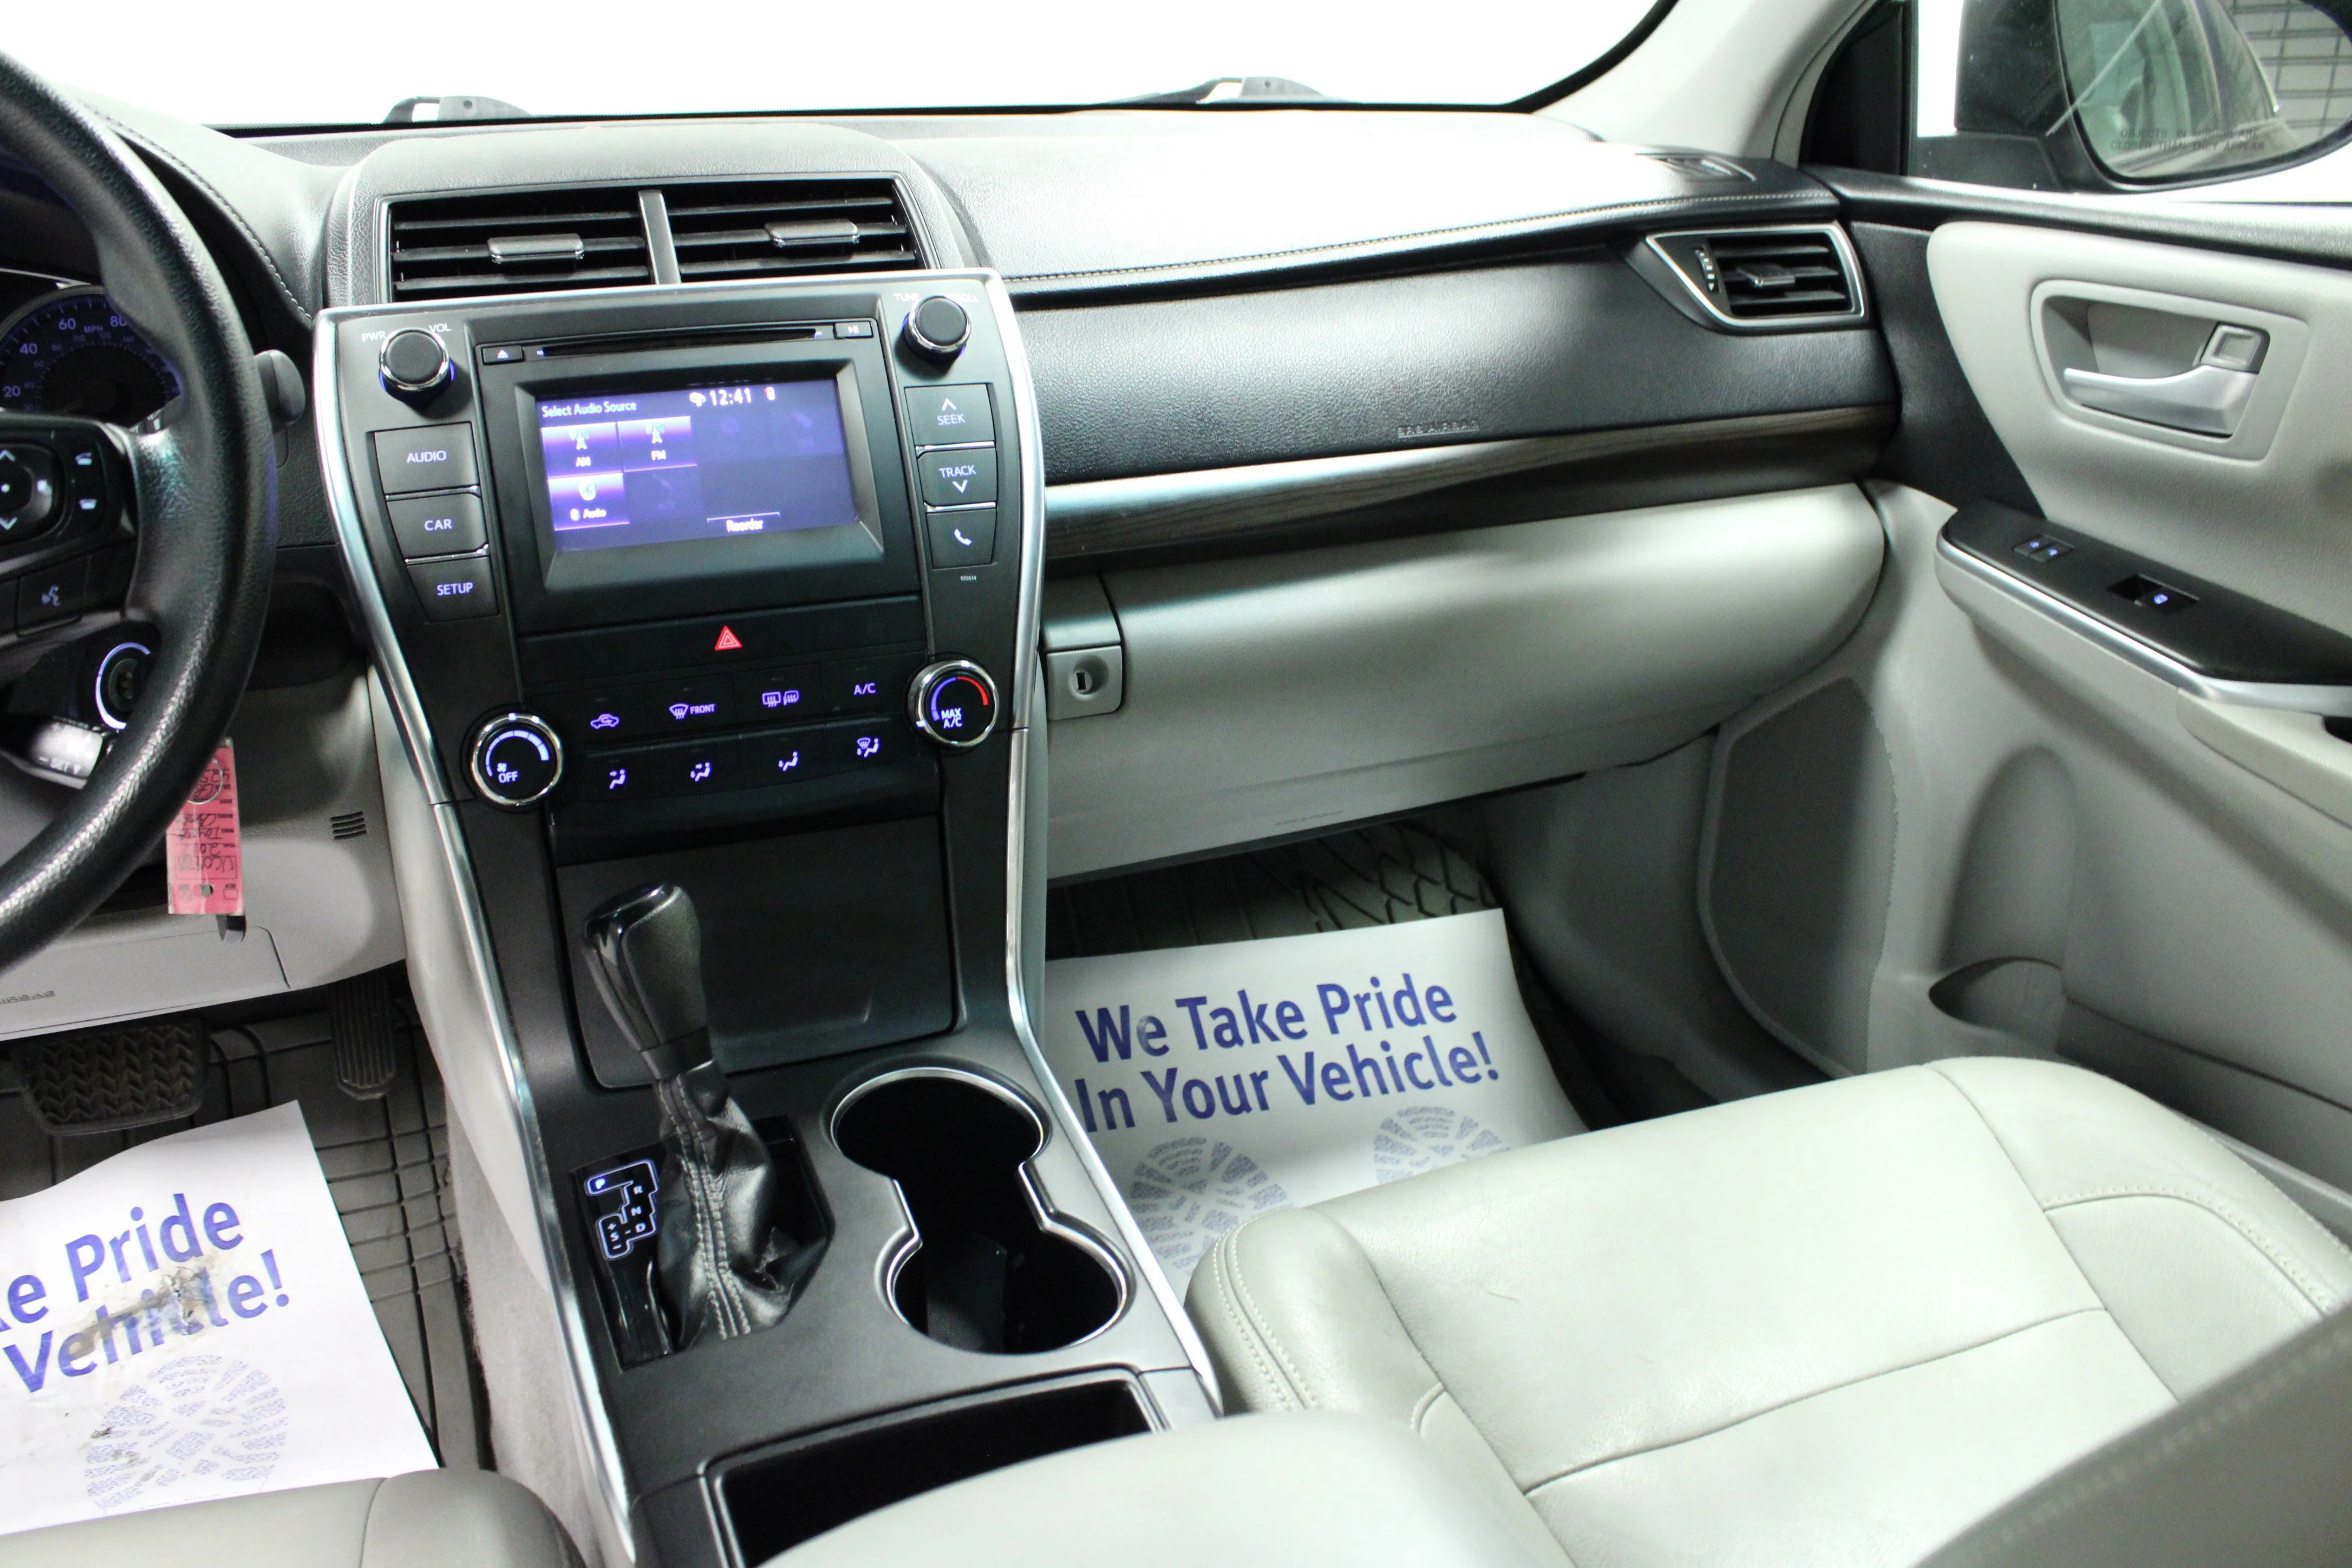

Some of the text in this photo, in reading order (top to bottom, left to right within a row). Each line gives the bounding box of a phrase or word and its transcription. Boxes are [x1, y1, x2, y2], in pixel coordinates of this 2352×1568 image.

[59, 318, 76, 330] 60
[110, 316, 127, 327] 80
[83, 325, 103, 334] MPH
[429, 323, 452, 334] VOL
[362, 331, 387, 342] PWR
[19, 343, 37, 354] 40
[3, 386, 21, 397] 20
[709, 387, 752, 406] 12:41
[541, 400, 637, 418] Select Audio Source
[937, 413, 966, 426] SEEK
[406, 450, 447, 463] AUDIO
[651, 450, 667, 461] FM
[575, 456, 592, 468] AM
[938, 464, 977, 479] TRACK
[583, 508, 607, 520] Audio
[424, 518, 453, 531] CAR
[726, 518, 764, 533] Reorder
[436, 582, 474, 596] SETUP
[854, 682, 877, 696] A/C
[690, 703, 716, 715] FRONT
[940, 707, 962, 720] MAX
[943, 717, 963, 729] A/C
[498, 770, 519, 784] OFF
[1074, 972, 1458, 1063] We Take Pride
[1074, 1031, 1500, 1133] In Your Vehicle!
[595, 1179, 606, 1190] P
[633, 1185, 643, 1195] R
[631, 1206, 642, 1216] N
[635, 1223, 646, 1233] D
[610, 1233, 619, 1242] S
[64, 1193, 244, 1304] Pride
